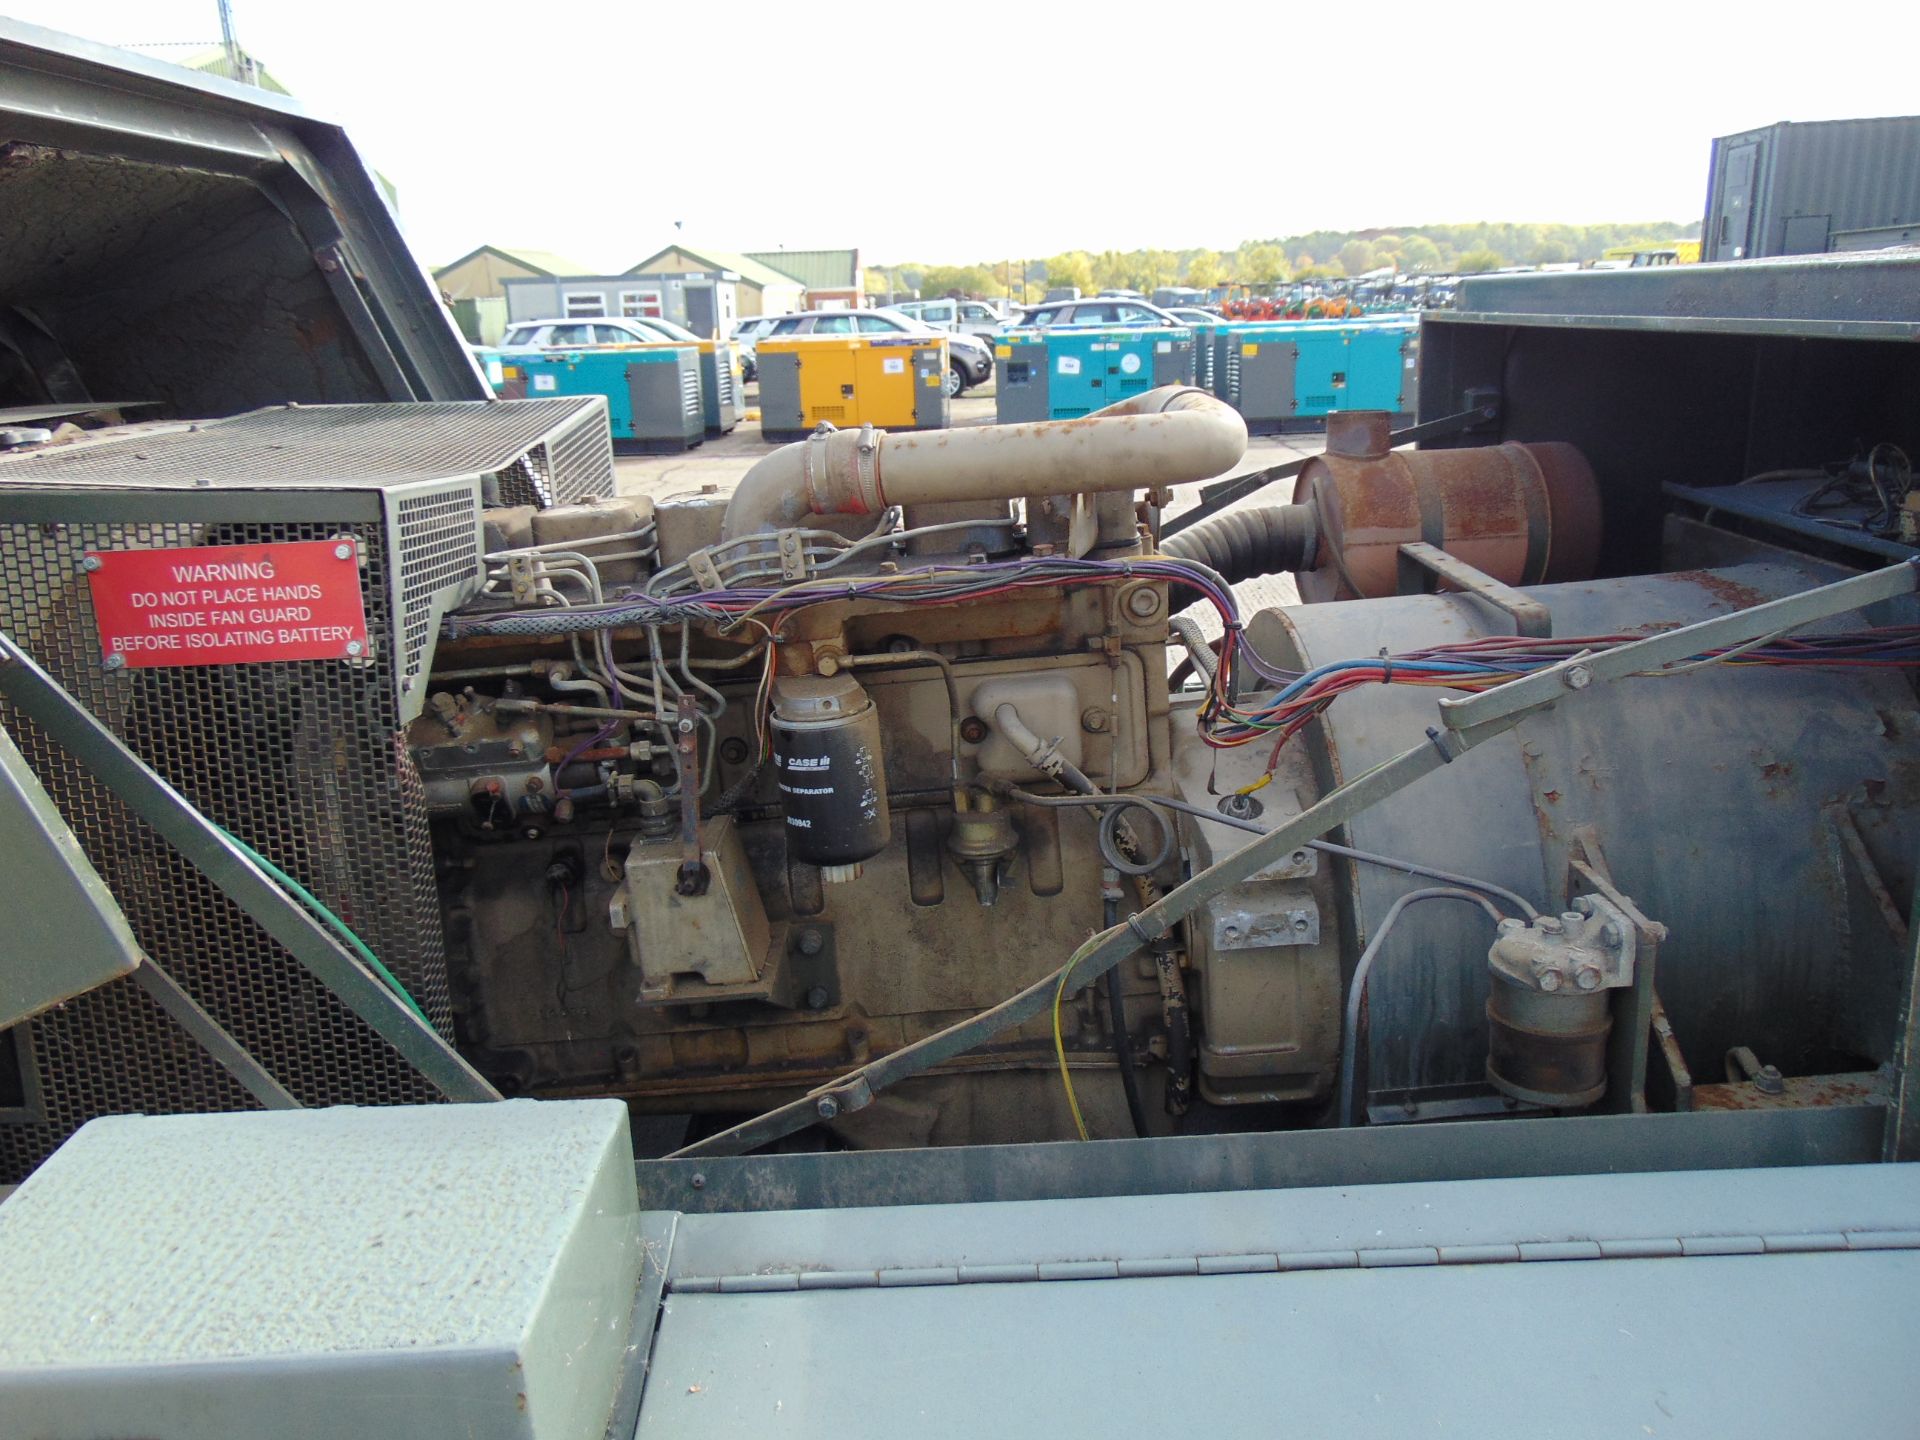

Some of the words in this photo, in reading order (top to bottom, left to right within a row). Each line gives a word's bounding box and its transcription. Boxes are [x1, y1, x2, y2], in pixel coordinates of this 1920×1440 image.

[172, 561, 276, 583] WARNING
[131, 592, 158, 608] DO
[162, 590, 198, 606] NOT
[201, 587, 258, 605] PLACE
[262, 584, 322, 601] HANDS
[148, 611, 207, 629] INSIDE
[211, 609, 245, 626] FAN
[249, 606, 311, 624] GUARD
[112, 634, 181, 651] BEFORE
[186, 630, 275, 648] ISOLATING
[279, 626, 354, 645] BATTERY
[788, 757, 818, 767] CASE
[792, 787, 834, 795] SEPARATOR
